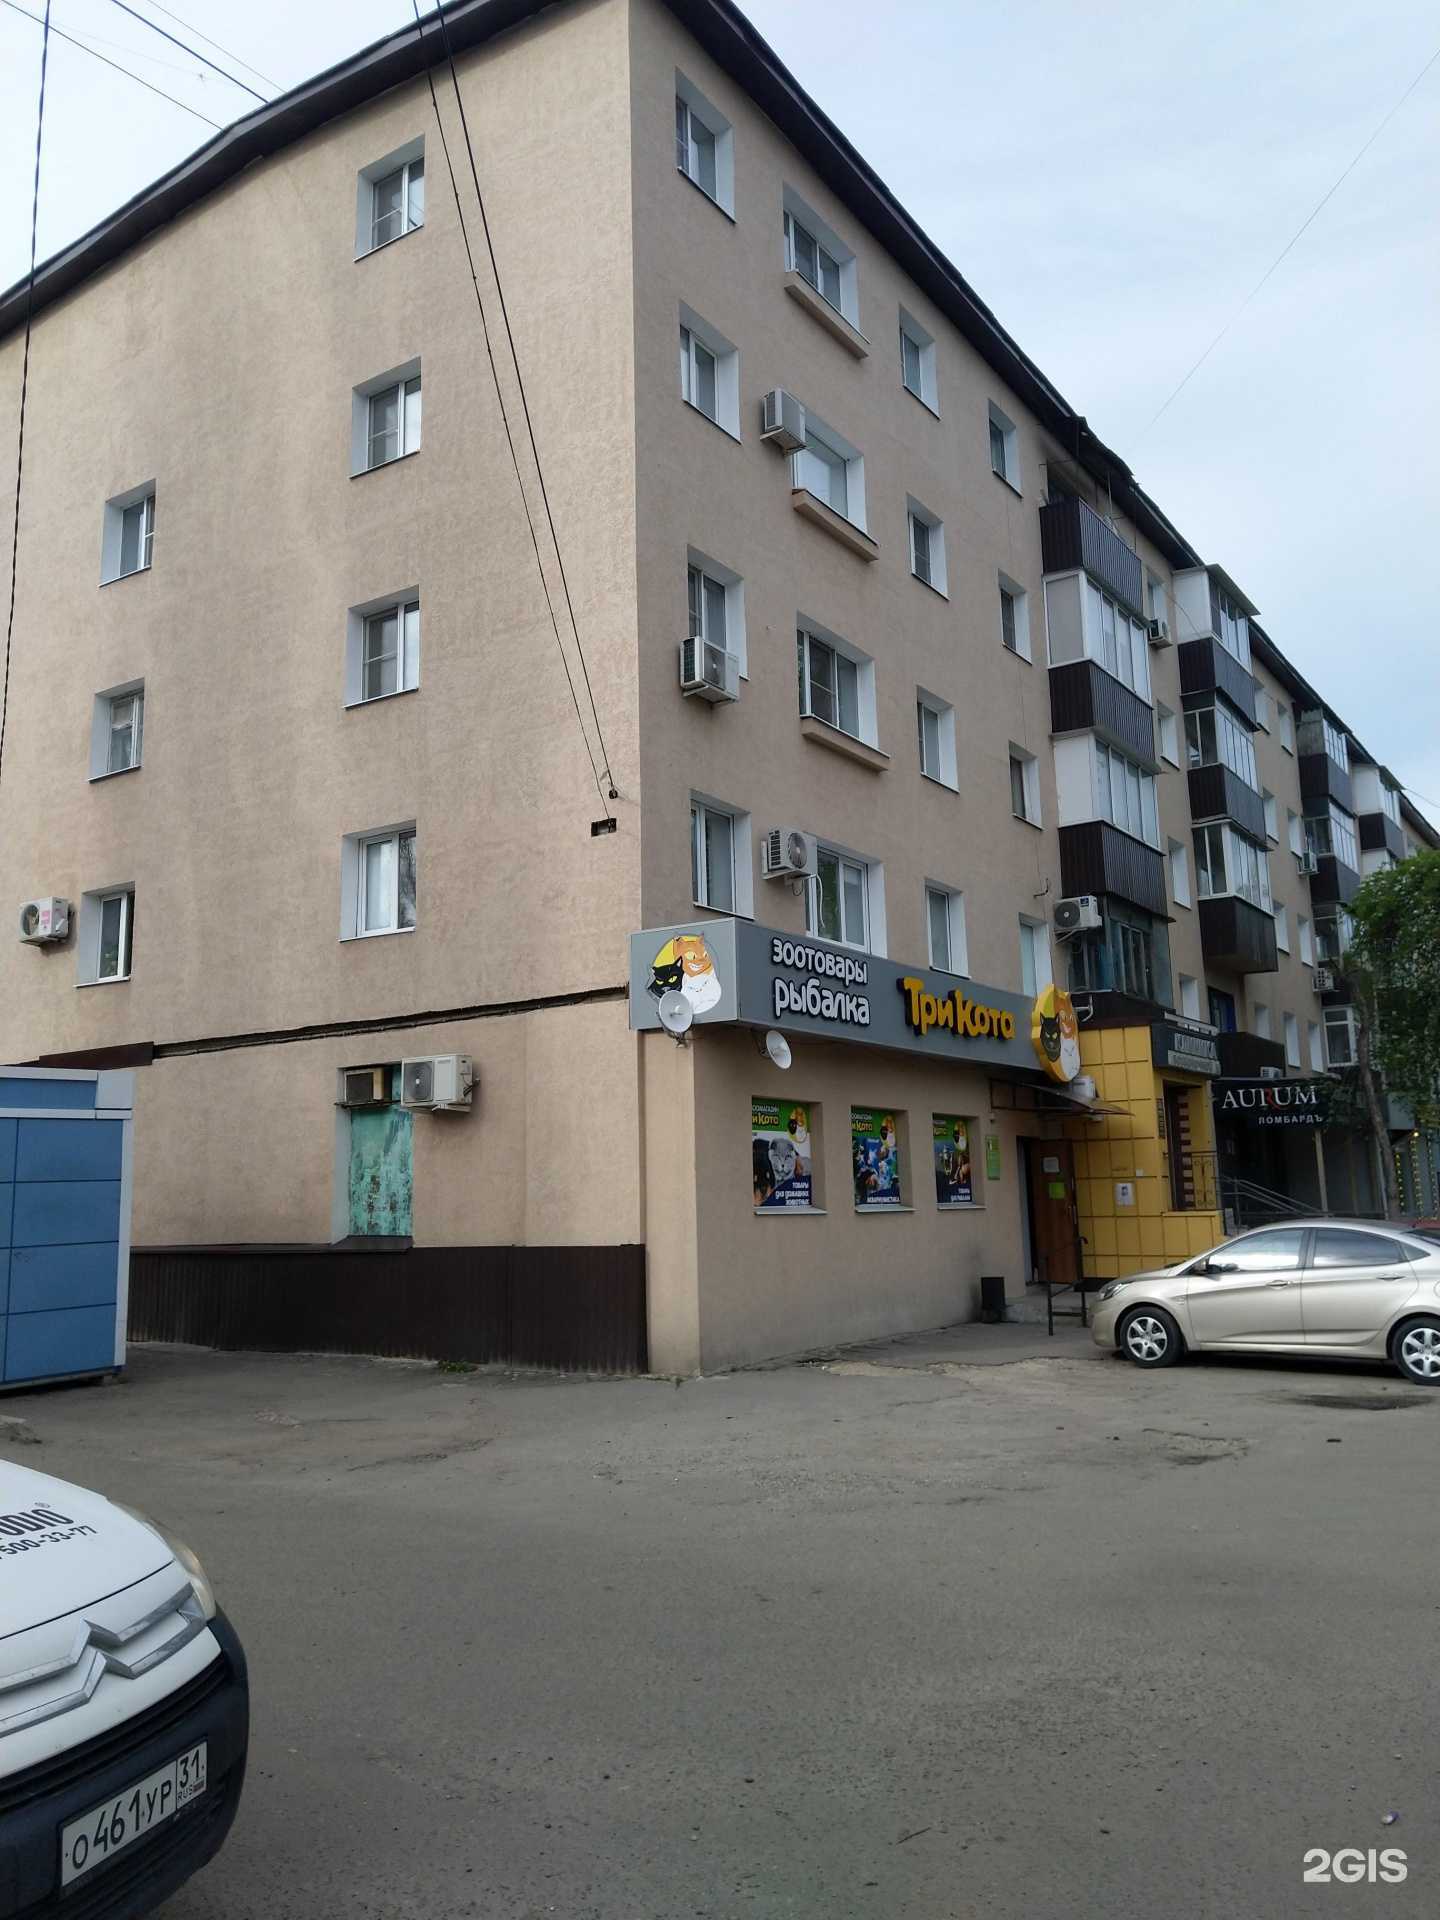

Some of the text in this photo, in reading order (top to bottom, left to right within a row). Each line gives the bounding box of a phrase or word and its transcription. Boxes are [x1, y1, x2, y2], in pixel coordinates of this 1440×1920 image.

[772, 938, 868, 986] зоотовары
[774, 977, 870, 1025] рыбалка
[1221, 1085, 1319, 1110] AURUM
[179, 1748, 200, 1789] 31
[177, 1784, 194, 1801] RUS
